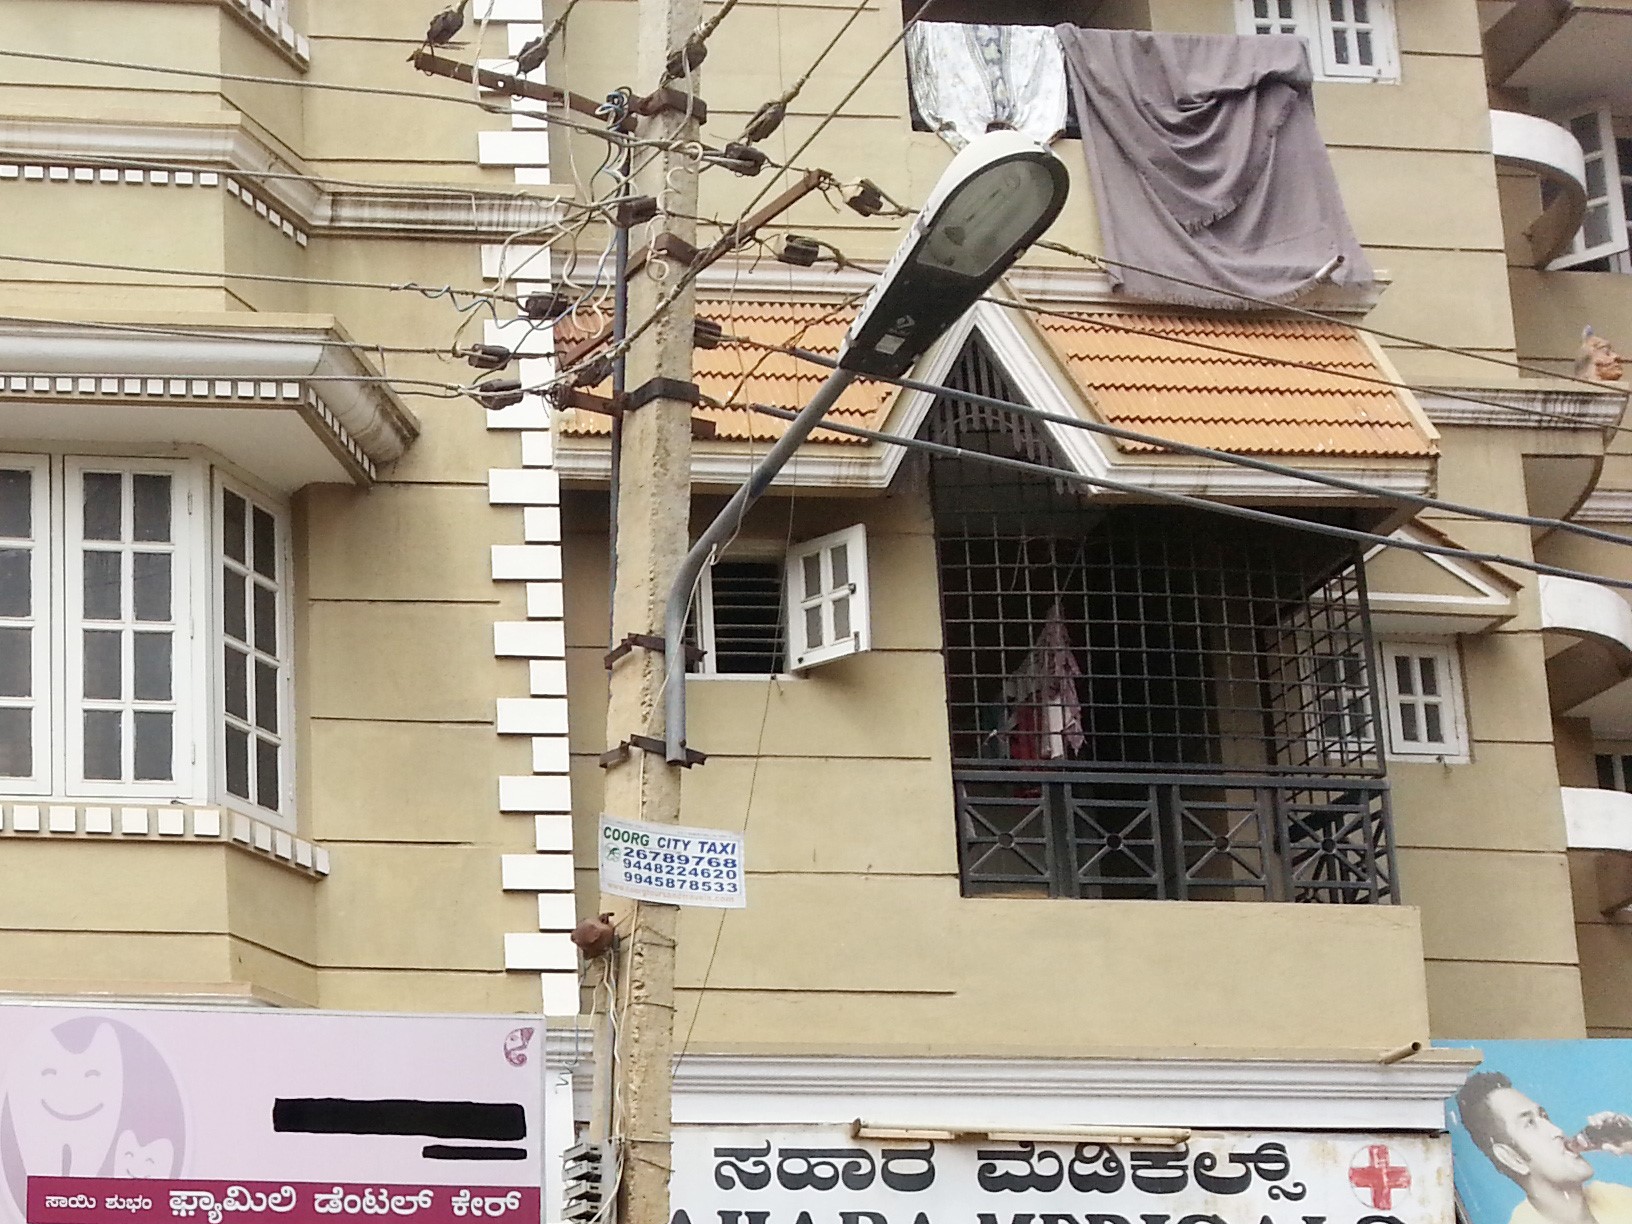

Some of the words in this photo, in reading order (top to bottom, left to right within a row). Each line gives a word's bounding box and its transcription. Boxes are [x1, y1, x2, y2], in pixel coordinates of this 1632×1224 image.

[603, 825, 651, 848] COORG
[656, 836, 692, 852] CITY
[698, 840, 738, 856] TAXI
[623, 846, 738, 869] 26789768
[622, 858, 738, 880] 9448224620
[623, 871, 739, 893] 9945878533
